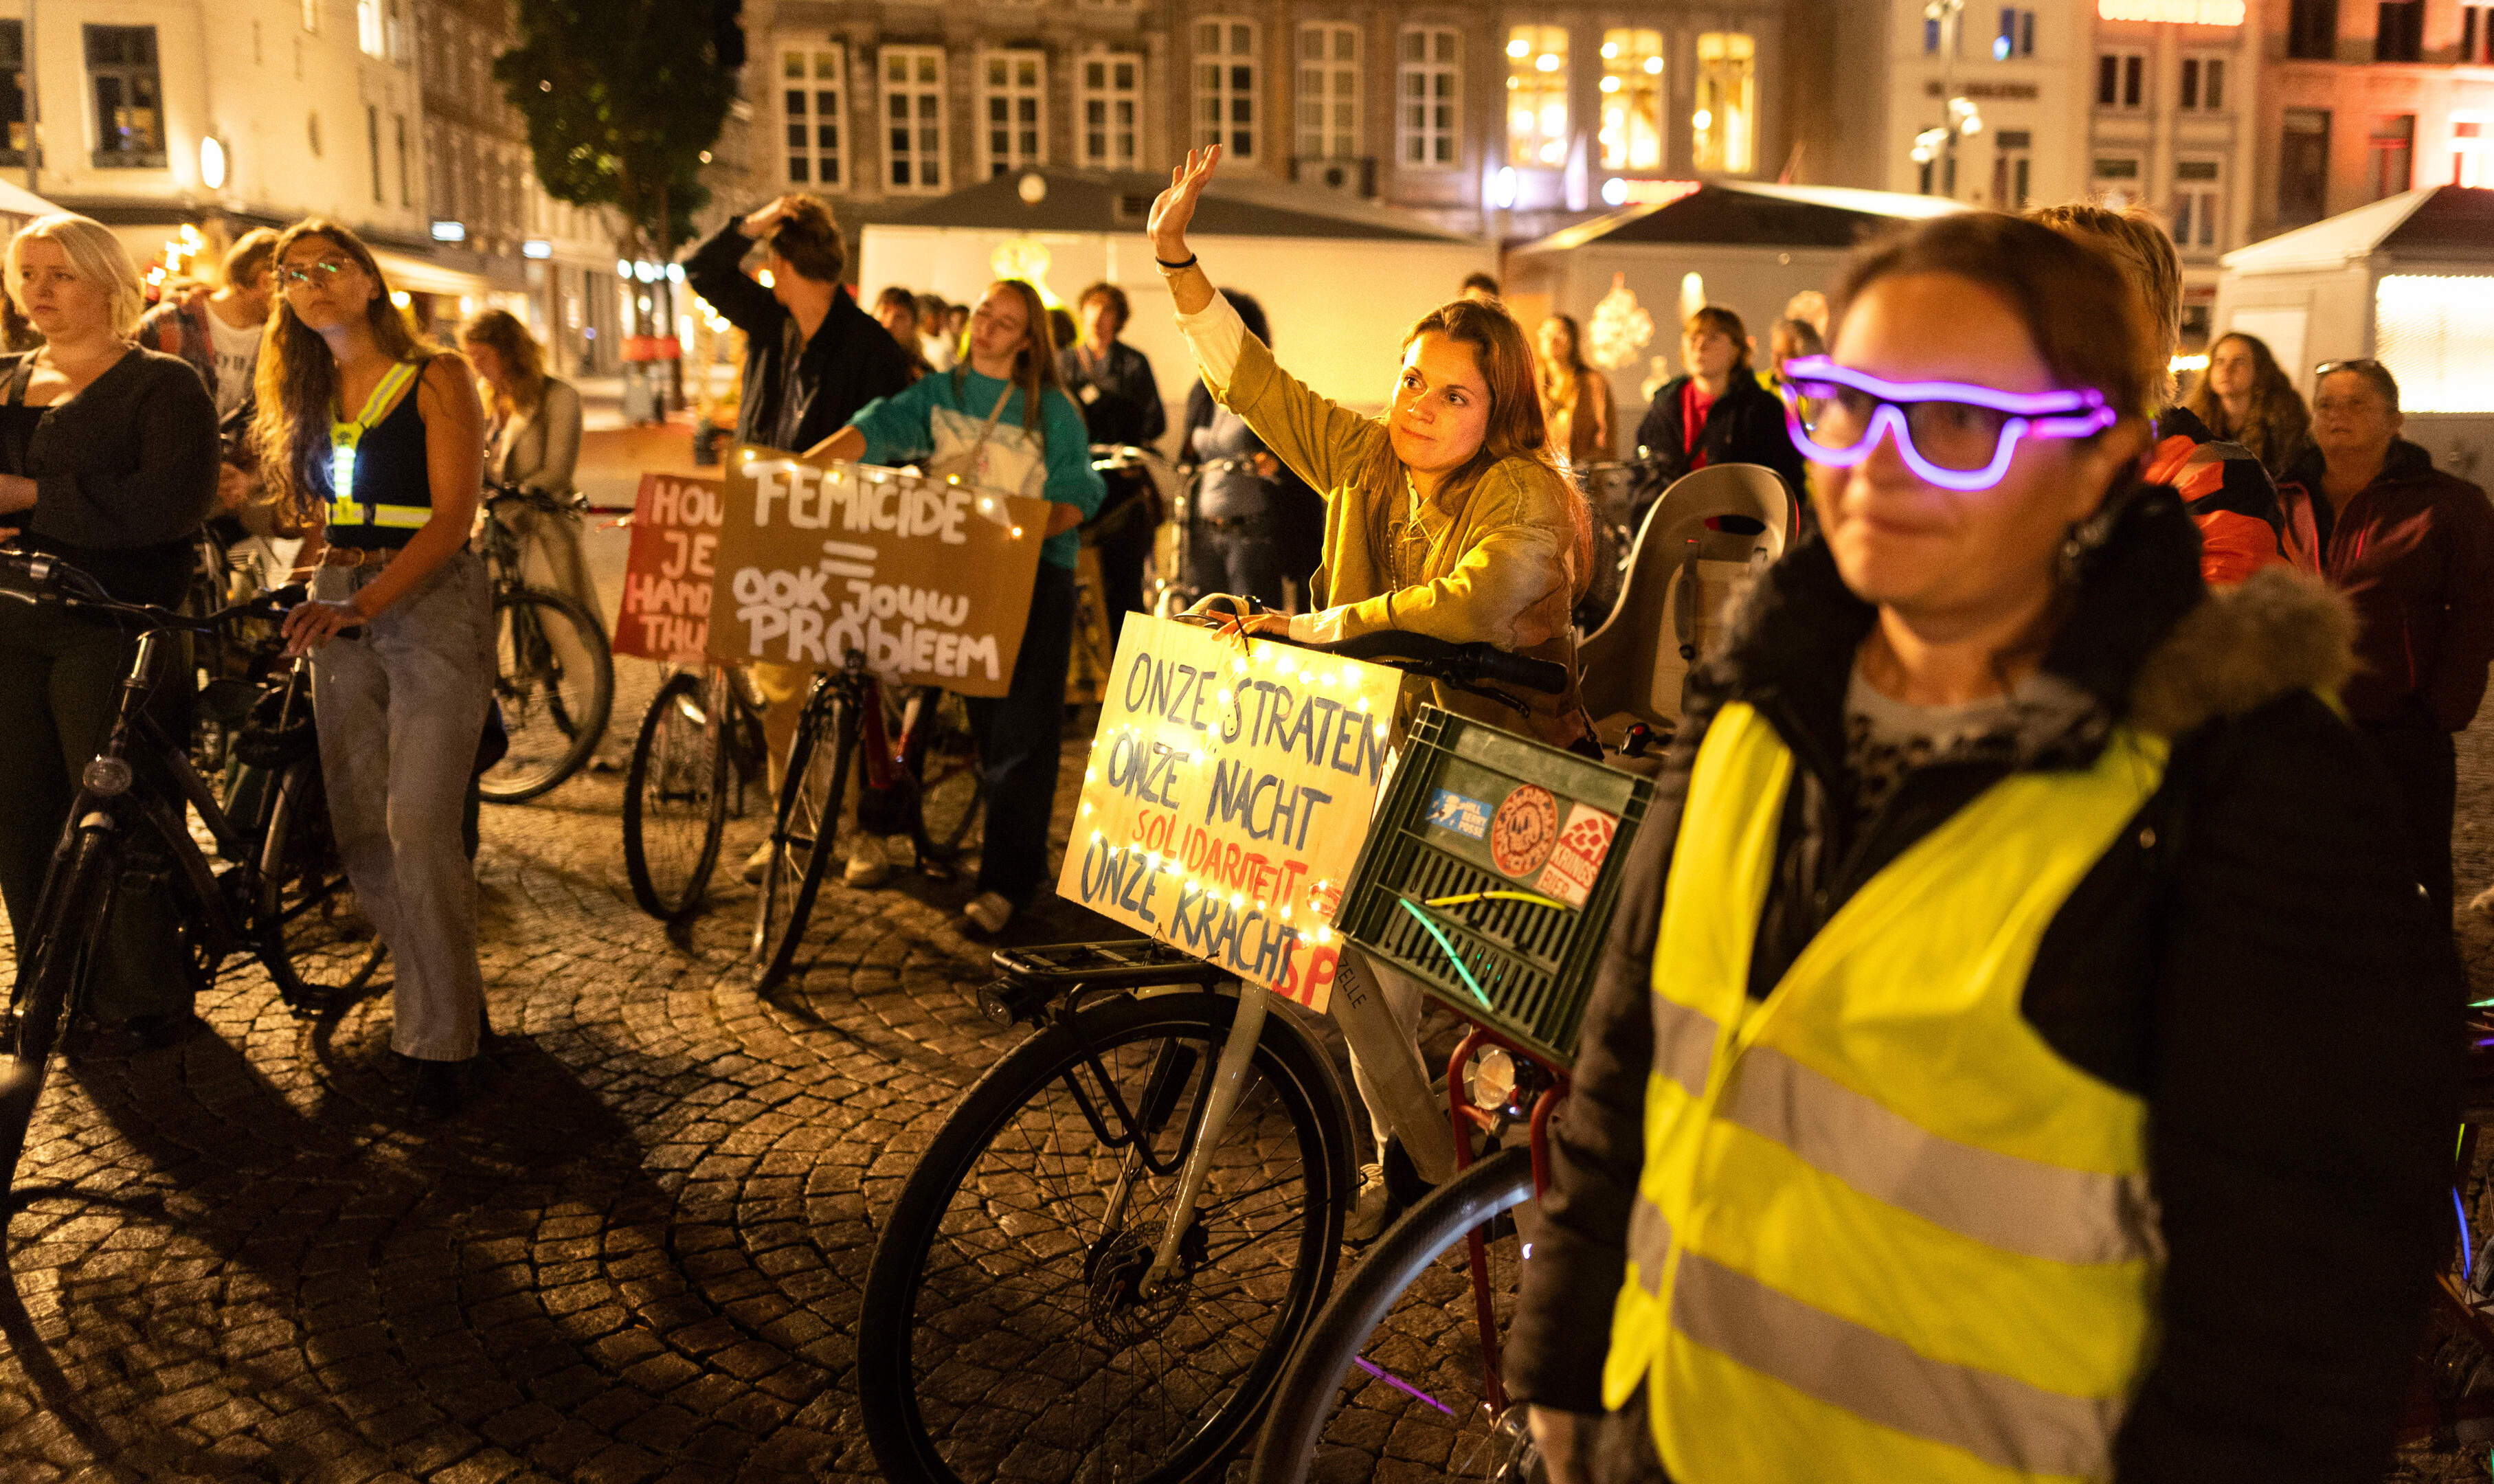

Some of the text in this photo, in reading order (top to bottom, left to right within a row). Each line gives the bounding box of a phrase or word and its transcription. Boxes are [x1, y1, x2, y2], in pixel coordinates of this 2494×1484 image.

[661, 529, 719, 578] JE
[732, 565, 832, 611] OOK
[1125, 652, 1392, 787] ONZE STRATEN
[1108, 732, 1334, 851] ONZE NACHT
[1132, 809, 1309, 909] SOLIDARITEIT
[1080, 836, 1303, 987] ONZE KRACHT
[1271, 938, 1340, 1008] SP
